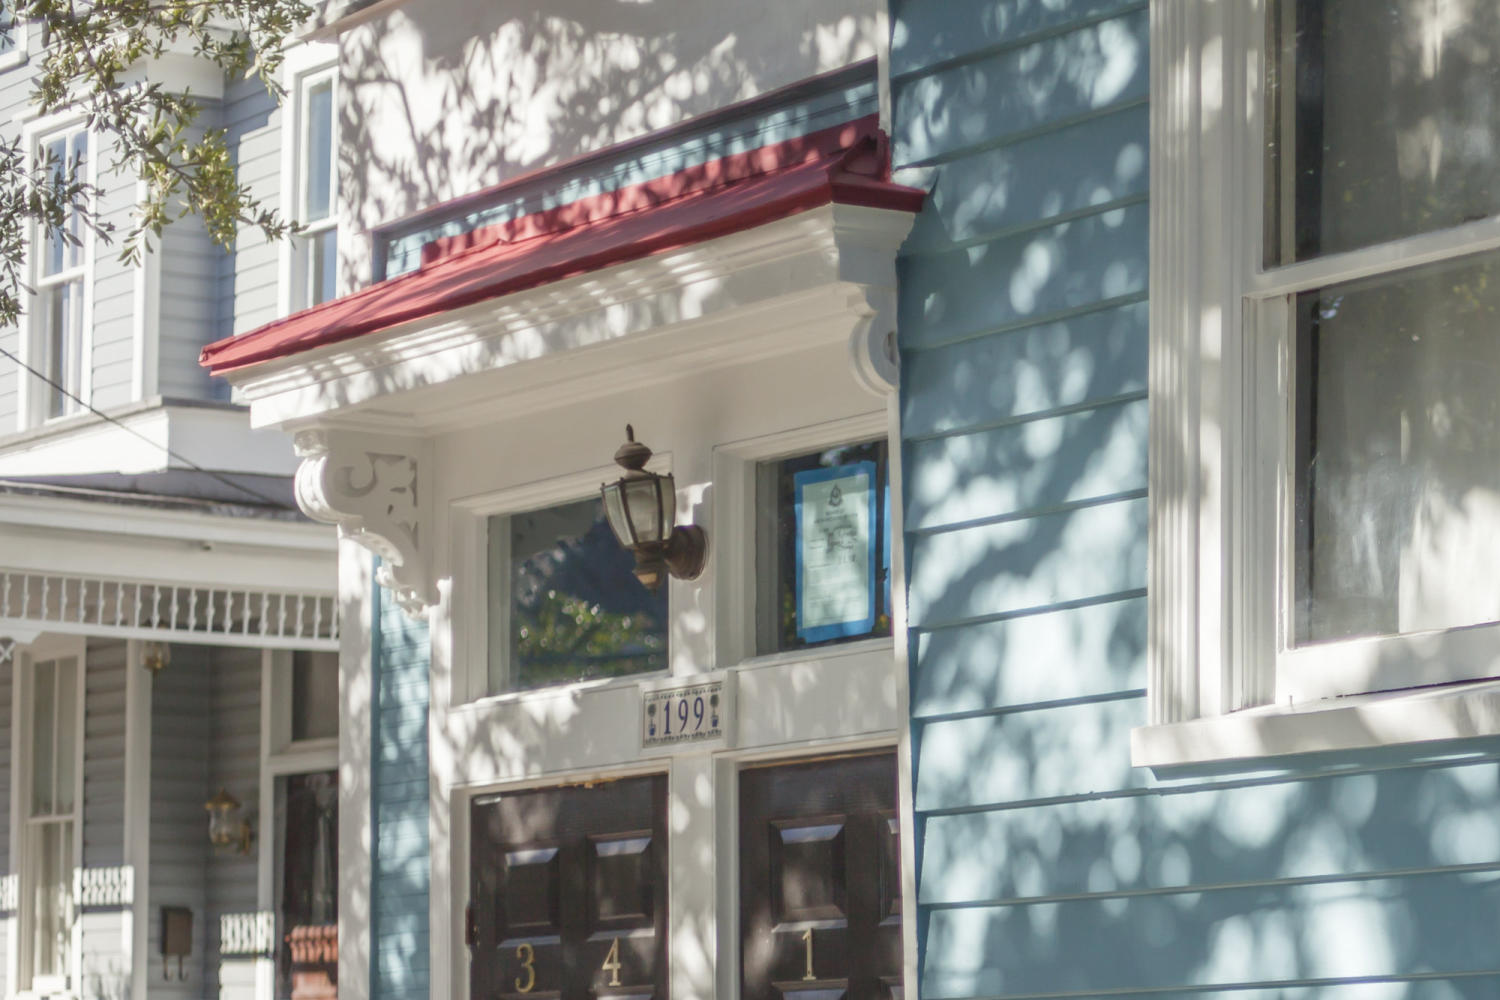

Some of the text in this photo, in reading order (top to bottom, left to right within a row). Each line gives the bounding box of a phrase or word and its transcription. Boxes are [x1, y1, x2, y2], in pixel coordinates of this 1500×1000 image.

[664, 697, 704, 734] 199
[515, 936, 622, 993] 3 4
[802, 928, 816, 981] 1
